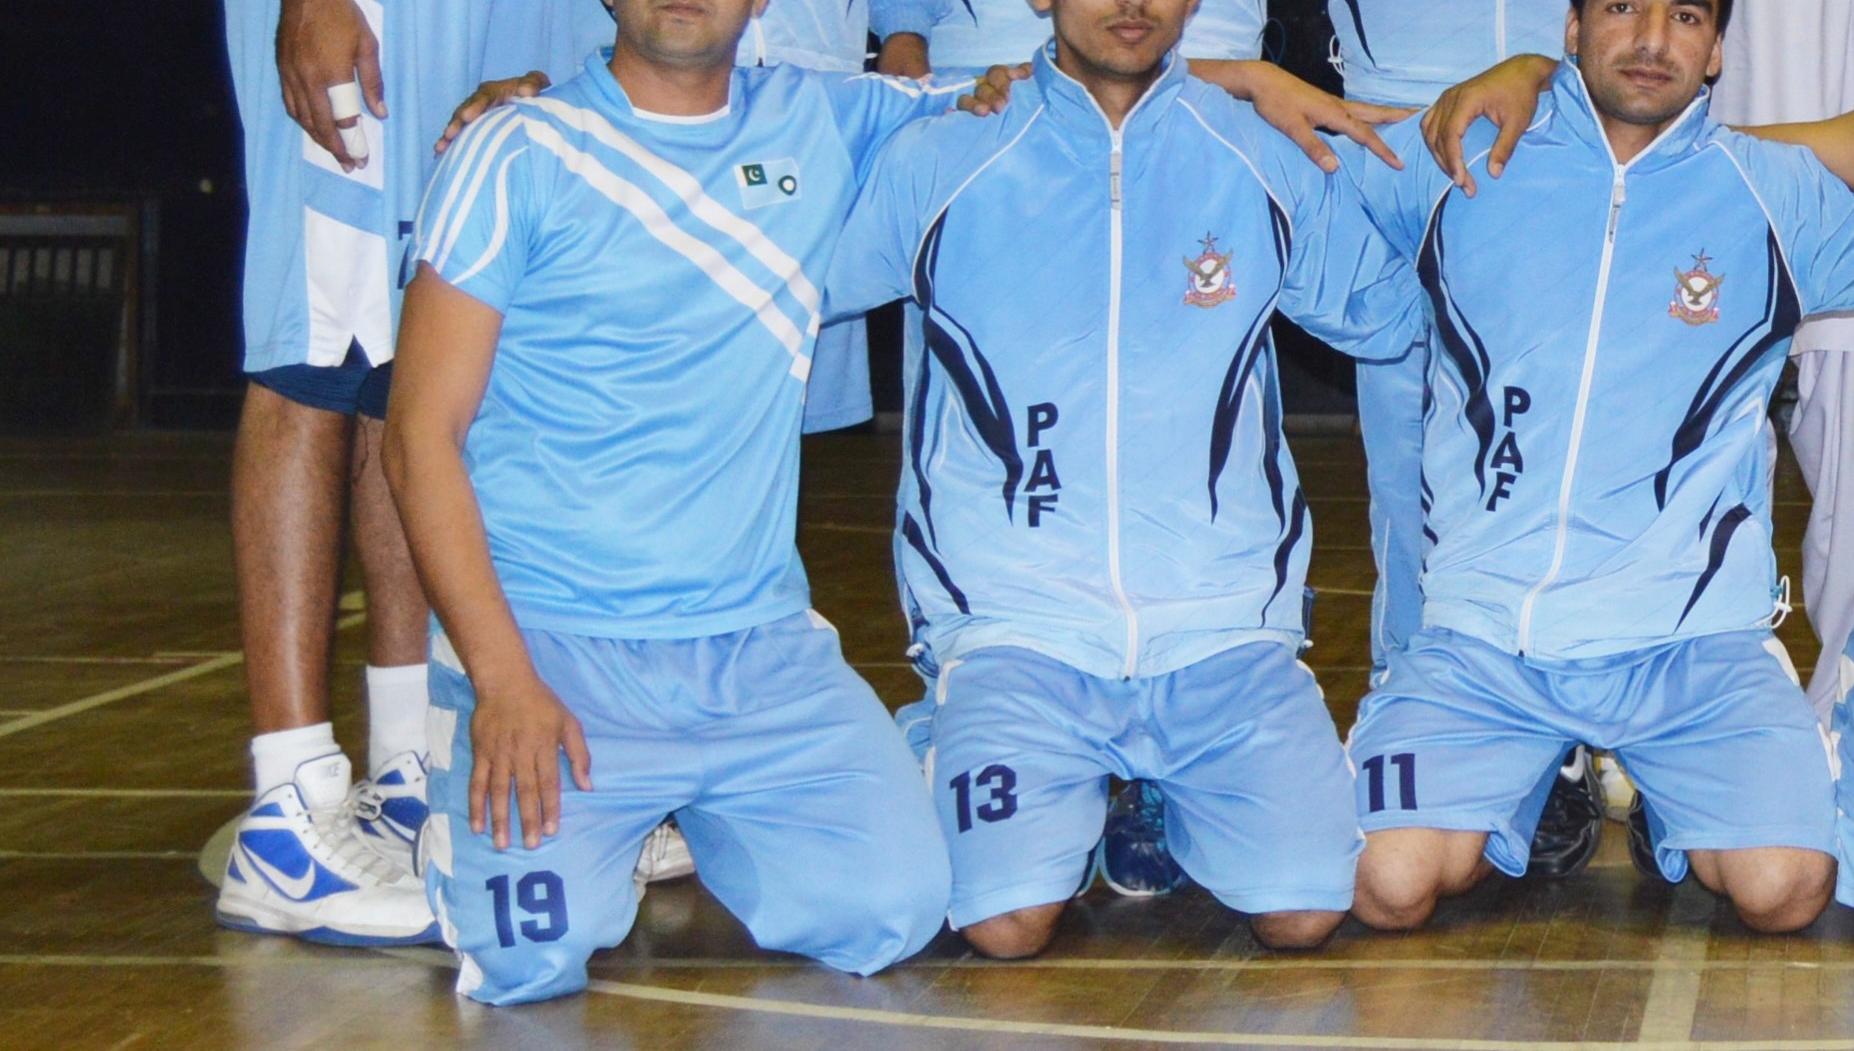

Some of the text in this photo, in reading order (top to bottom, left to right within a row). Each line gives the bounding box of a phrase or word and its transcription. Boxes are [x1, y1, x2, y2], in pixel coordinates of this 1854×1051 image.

[1024, 402, 1061, 528] PAF
[1486, 385, 1531, 512] PAF
[949, 764, 1018, 834] 13
[1361, 752, 1418, 814] 11
[485, 870, 569, 949] 19
